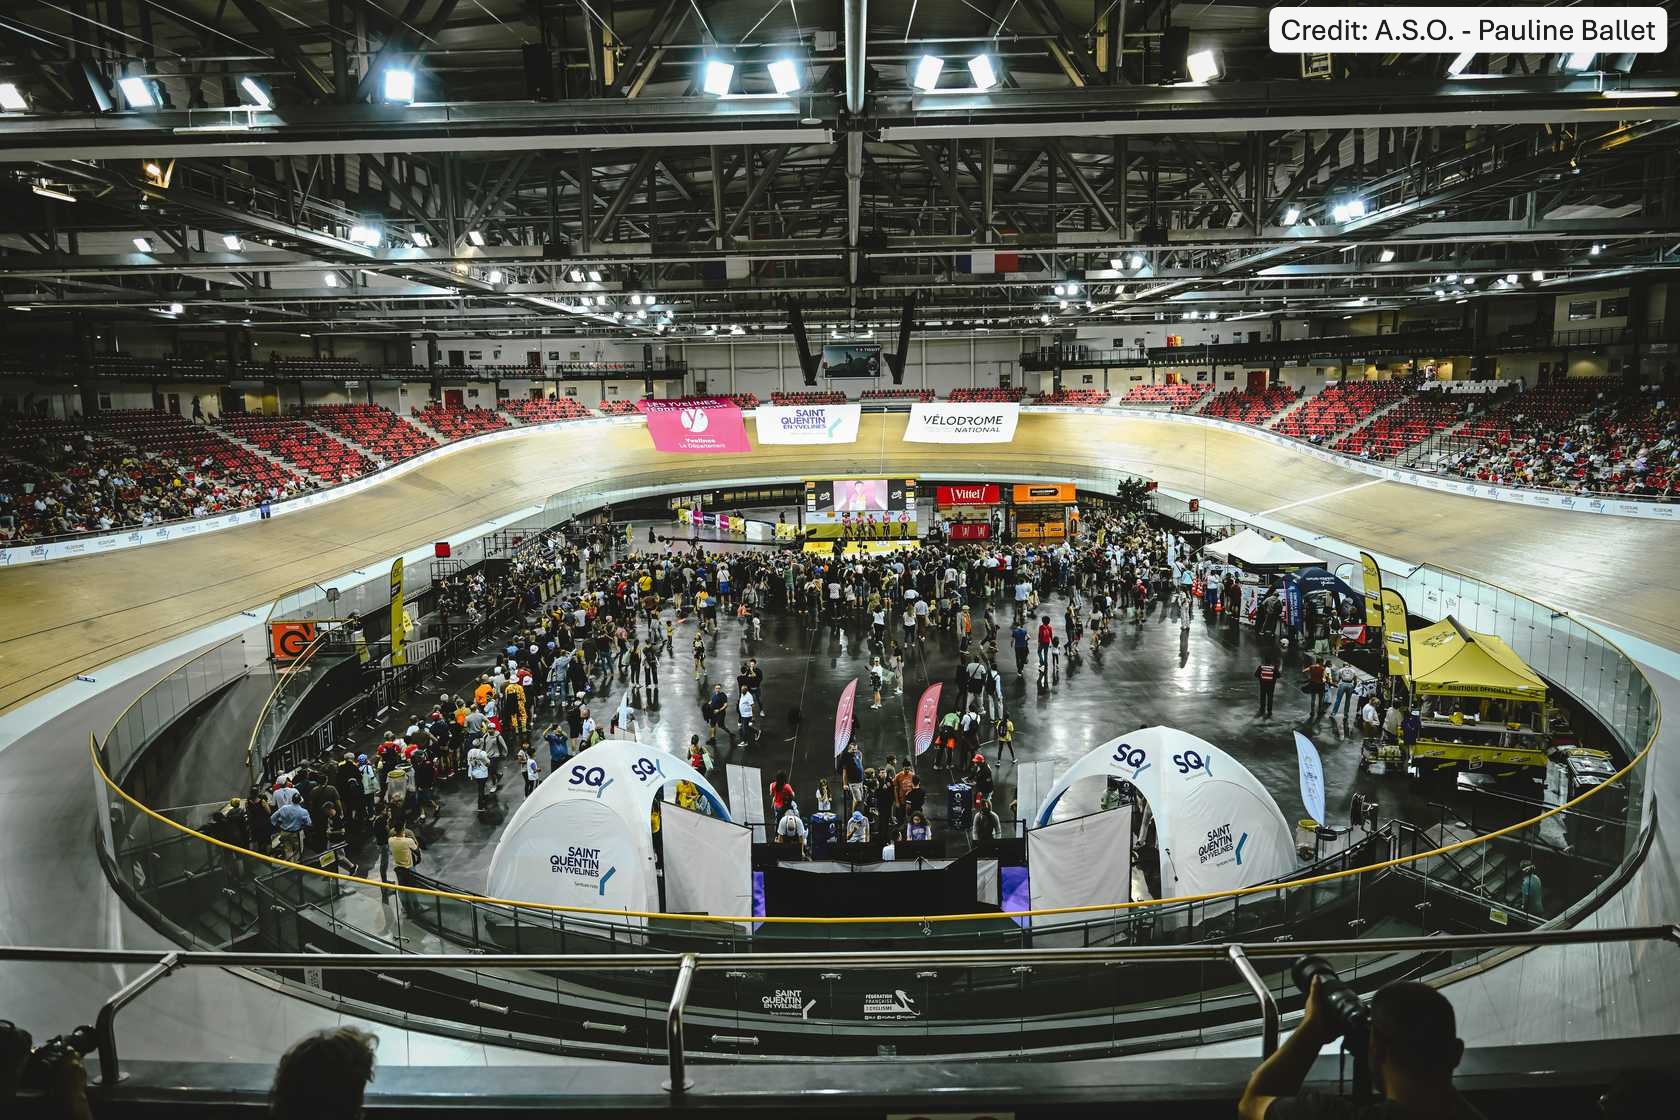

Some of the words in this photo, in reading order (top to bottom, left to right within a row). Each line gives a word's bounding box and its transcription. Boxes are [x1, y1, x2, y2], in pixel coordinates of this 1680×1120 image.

[795, 408, 825, 417] SAINT
[923, 412, 1004, 426] VÉLODROME
[781, 416, 826, 425] QUENTIN
[955, 489, 980, 499] Vittel
[1207, 823, 1230, 842] SAINT
[1198, 833, 1232, 857] QUENTIN
[568, 846, 600, 860] SAINT
[1200, 854, 1208, 864] EN
[1207, 843, 1234, 860] YVELINES
[550, 855, 599, 870] QUENTIN
[551, 865, 563, 873] EN
[564, 866, 599, 878] YVELINES
[775, 989, 802, 997] SAINT
[761, 996, 802, 1004] QUENTIN
